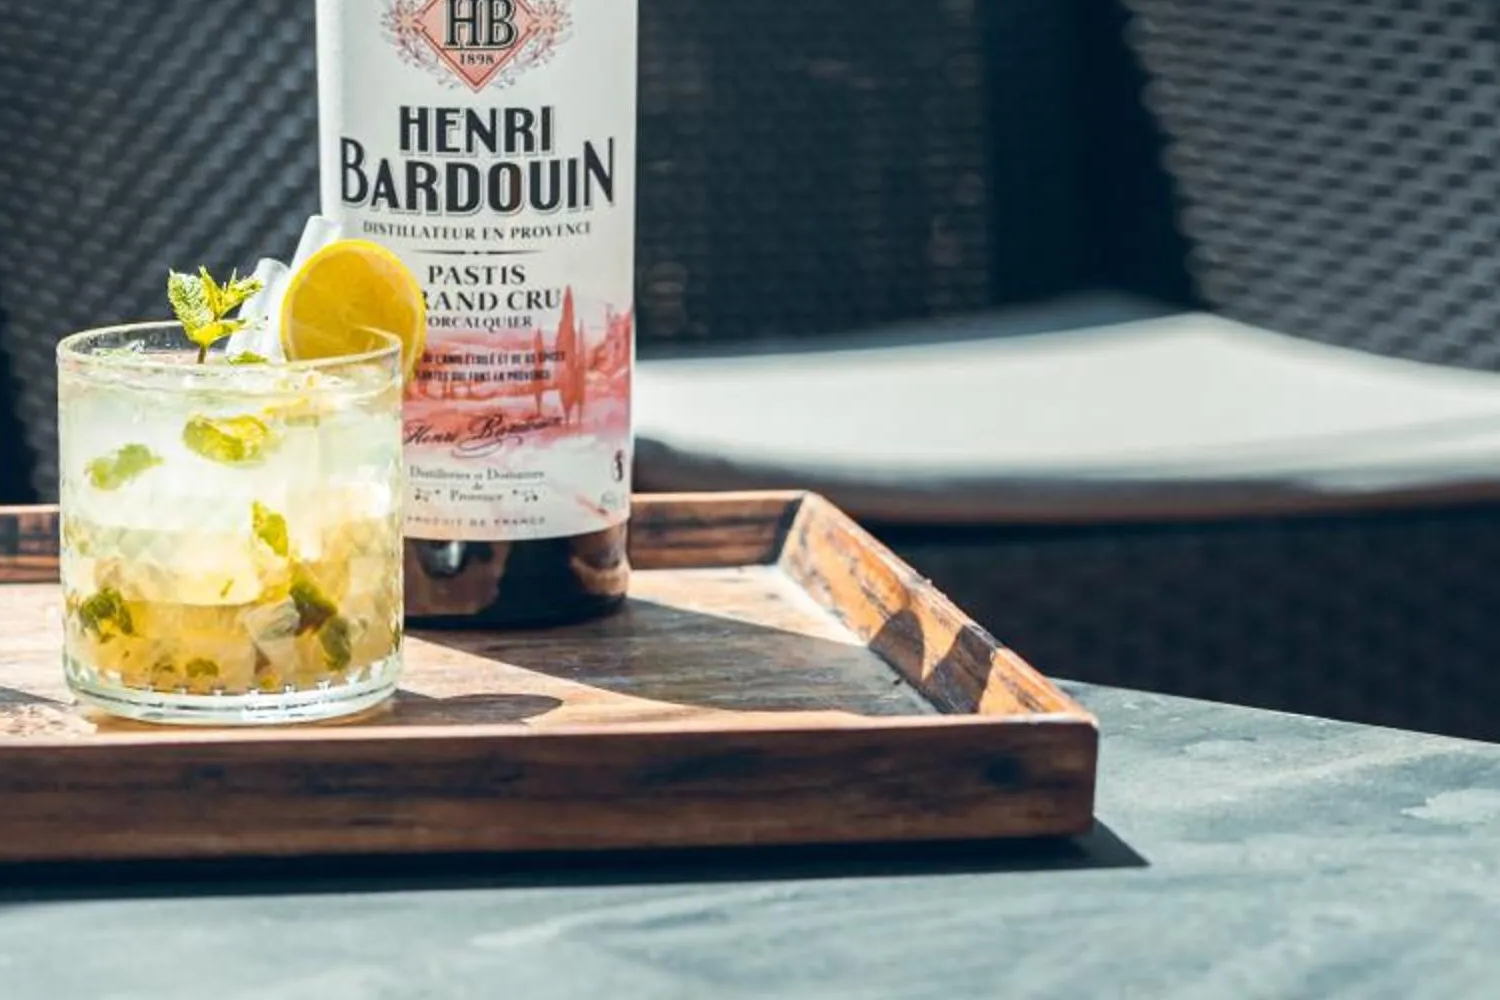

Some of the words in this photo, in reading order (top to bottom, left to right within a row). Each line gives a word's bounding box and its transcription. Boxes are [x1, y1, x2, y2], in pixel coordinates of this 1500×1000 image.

[459, 53, 495, 65] 1898
[400, 105, 554, 156] HENRI
[340, 136, 615, 215] BARDOUIN
[363, 221, 476, 241] DISTILLATEUR
[482, 228, 504, 241] EN
[510, 221, 592, 240] PROVENCE
[428, 265, 526, 285] PASTIS
[421, 290, 498, 311] AND
[507, 289, 560, 309] CRU
[425, 315, 533, 333] ORCALQUIER
